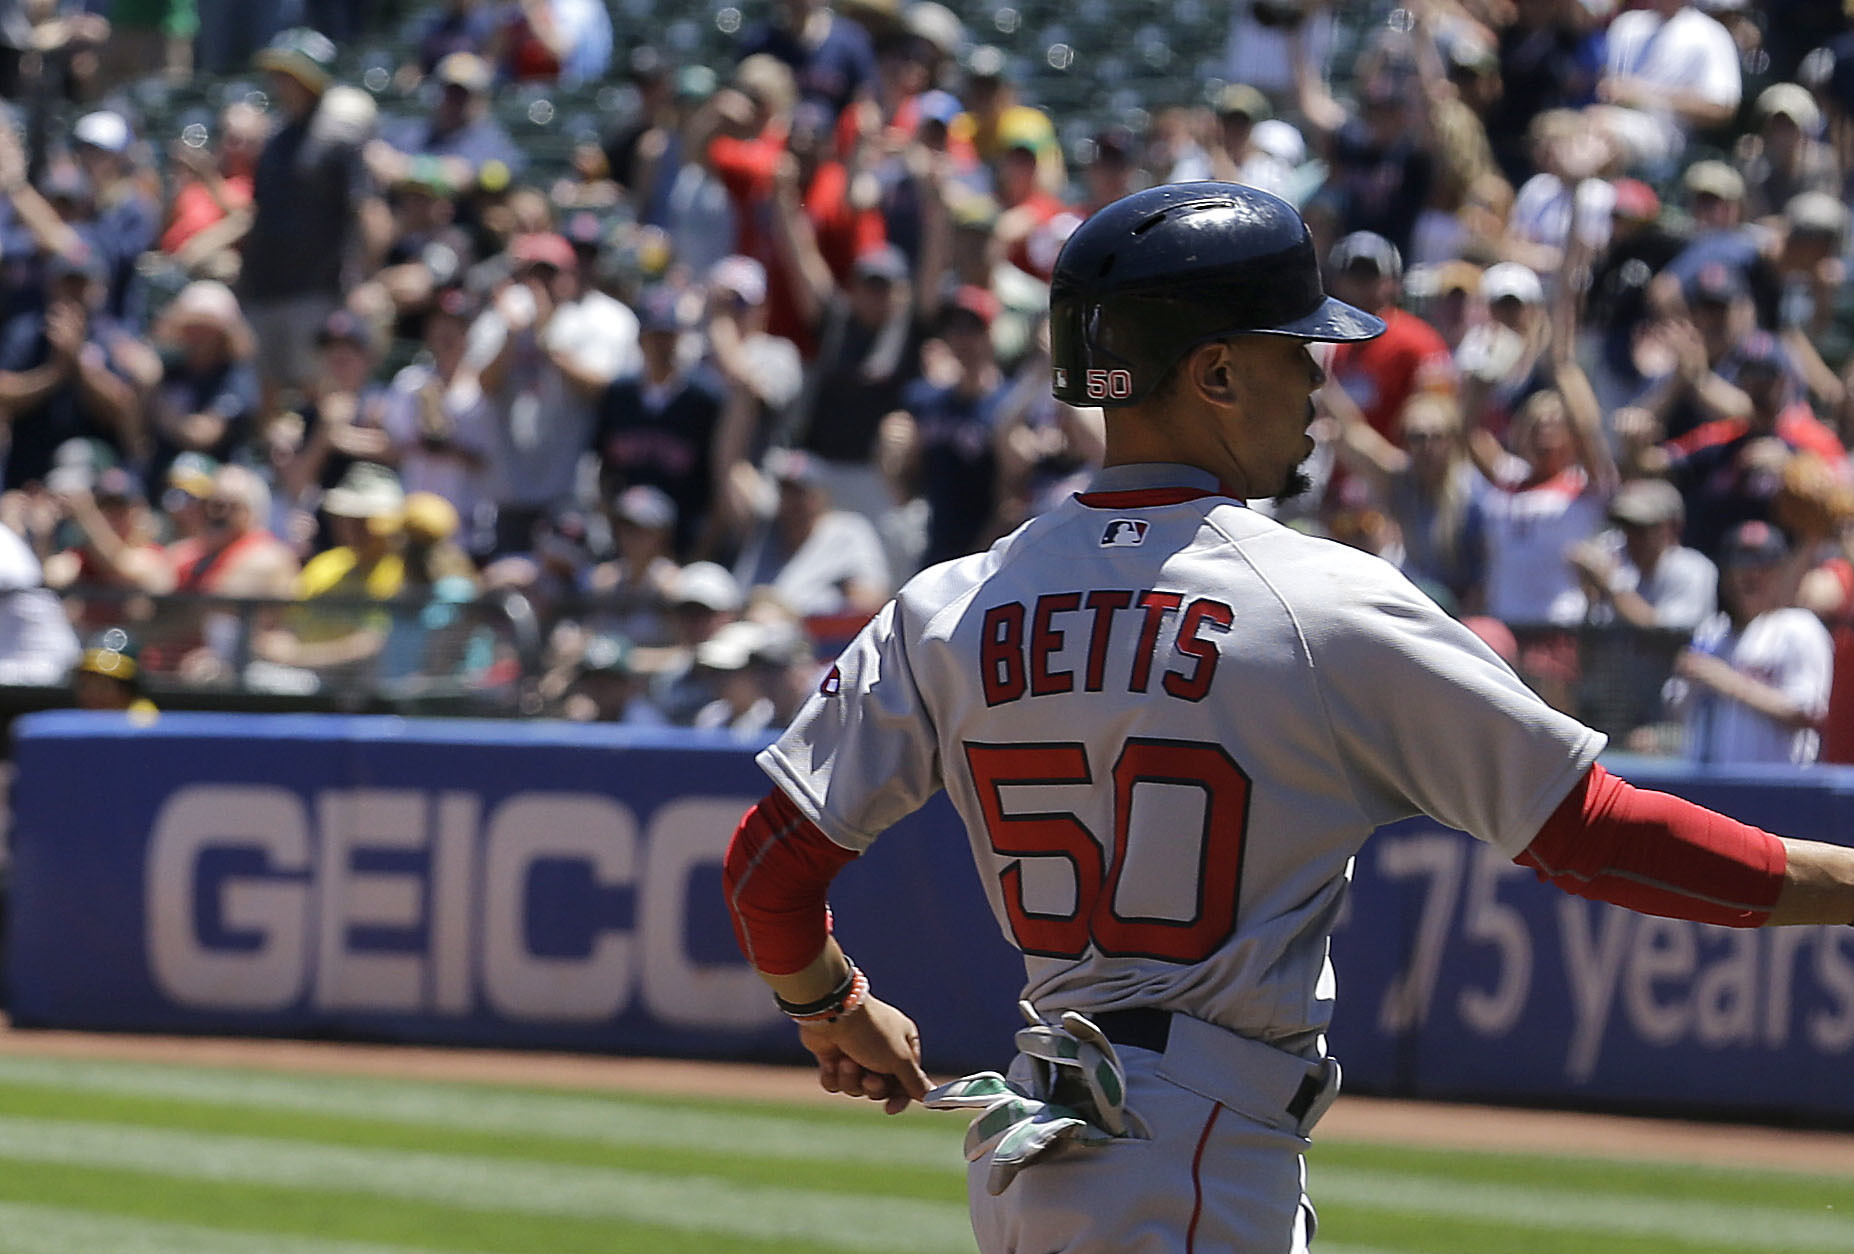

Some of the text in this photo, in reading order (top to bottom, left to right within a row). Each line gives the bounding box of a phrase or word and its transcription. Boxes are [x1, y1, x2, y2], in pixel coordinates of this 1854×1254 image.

[1086, 369, 1132, 399] 50
[980, 589, 1235, 708] BETTS
[963, 736, 1252, 966] 50
[1376, 832, 1534, 1037] 75
